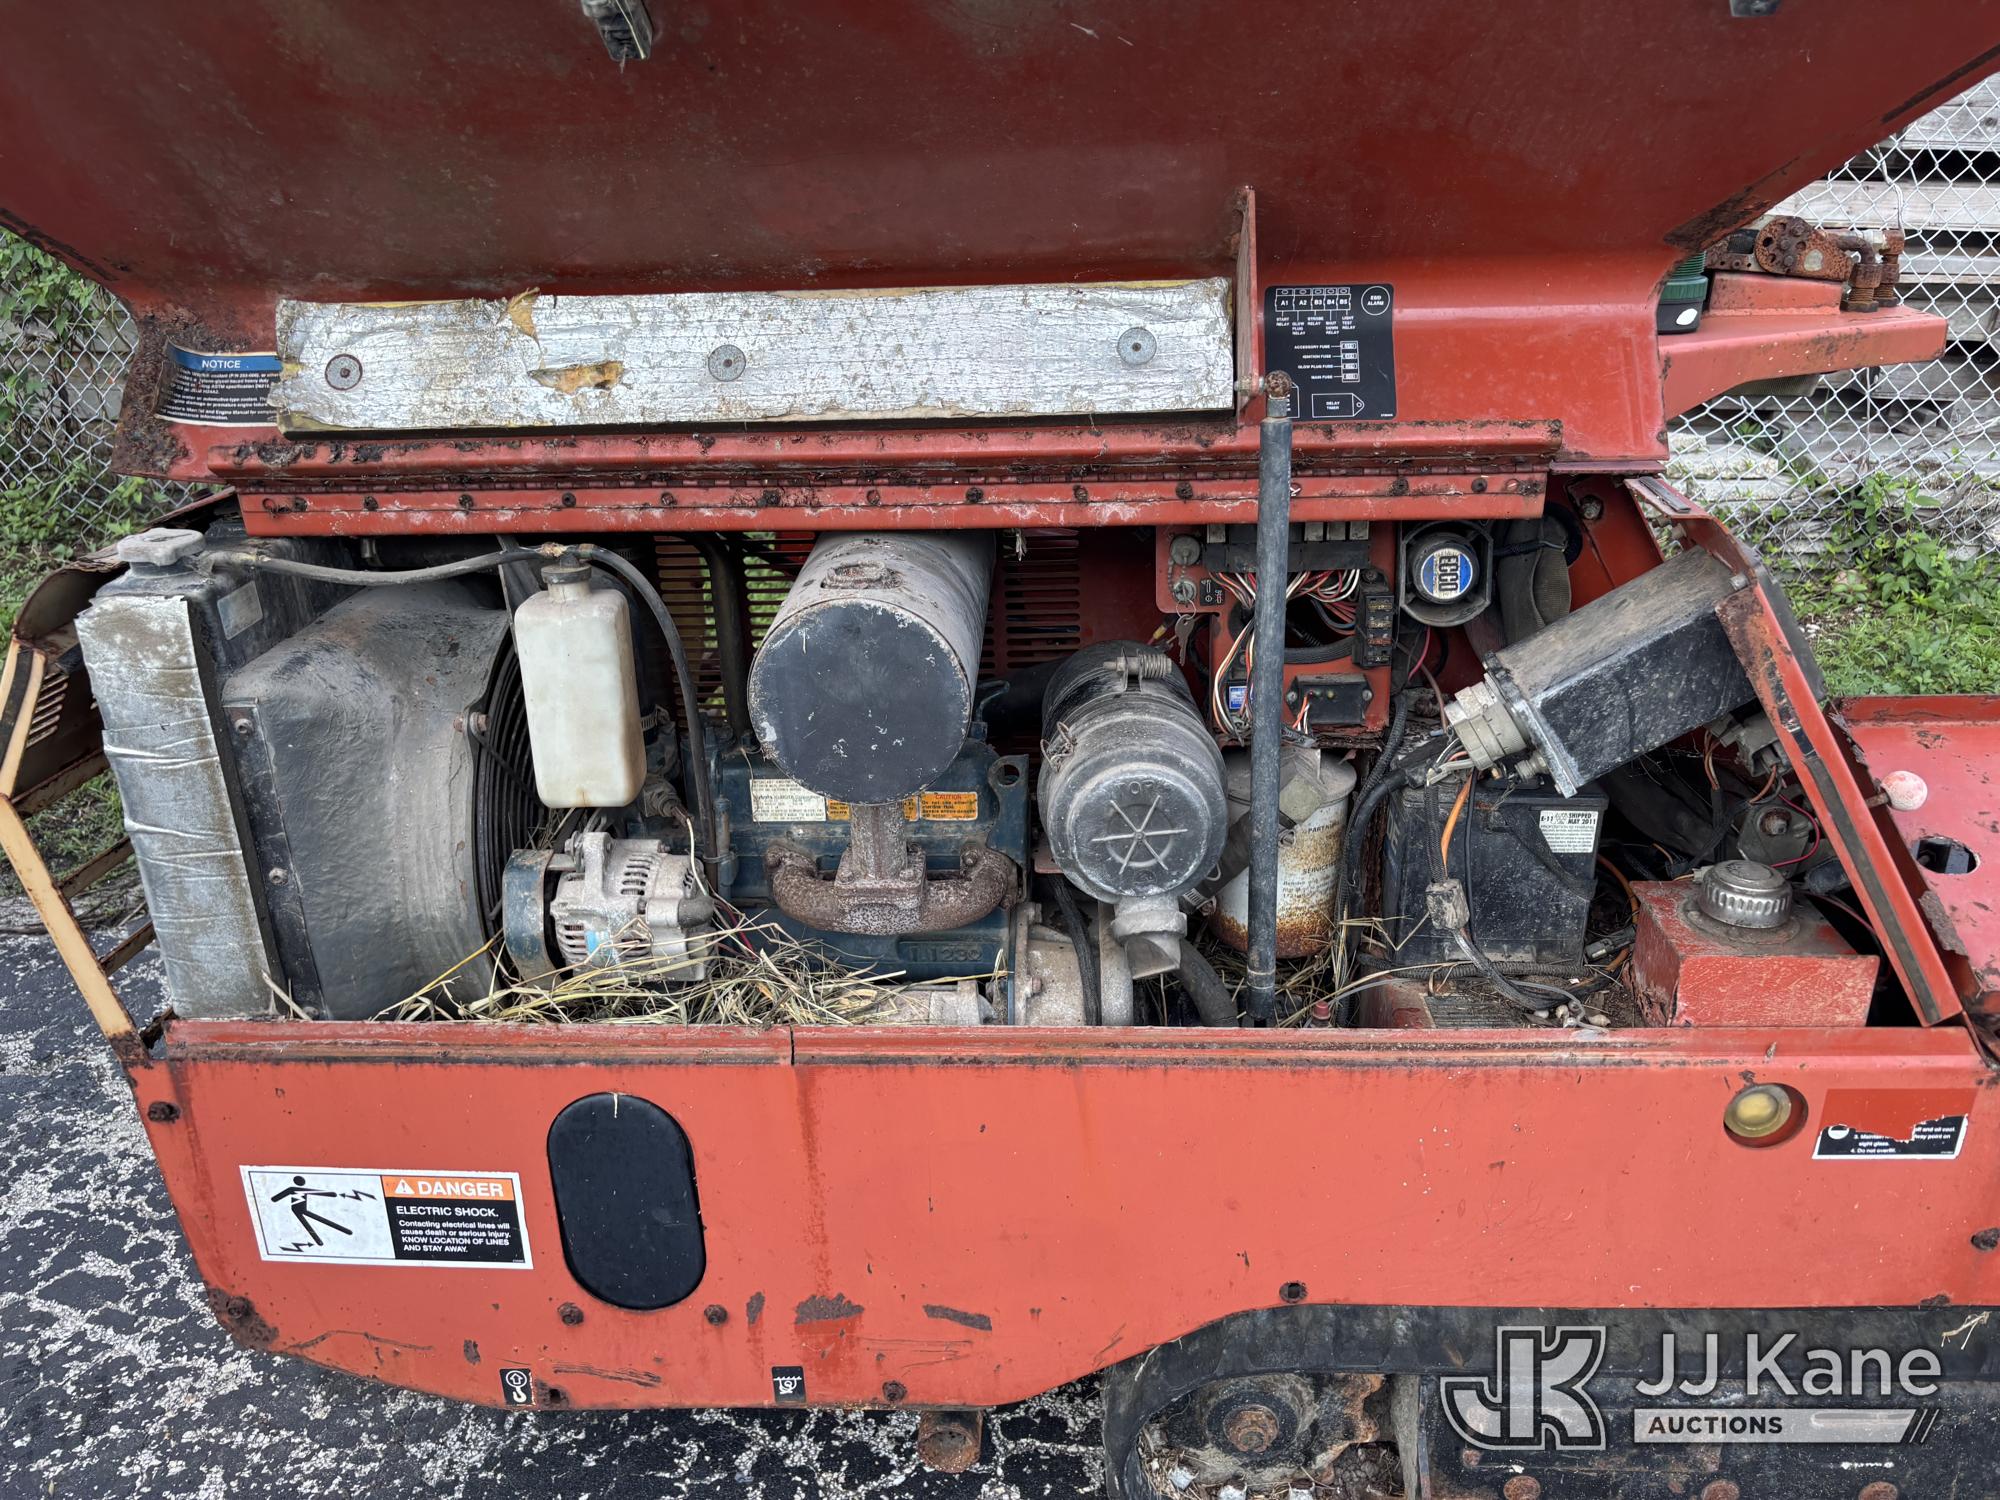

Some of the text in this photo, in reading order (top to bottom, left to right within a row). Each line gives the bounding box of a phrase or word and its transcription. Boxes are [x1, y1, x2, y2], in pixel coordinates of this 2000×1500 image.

[202, 360, 241, 369] NOTICE
[1438, 556, 1458, 592] ECCO
[417, 1181, 505, 1197] DANGER
[396, 1206, 499, 1217] ELECTRIC SHOCK.
[399, 1220, 440, 1229] Contacting
[442, 1221, 476, 1229] electrical
[488, 1231, 511, 1239] injury.
[402, 1236, 428, 1244] KNOW
[430, 1237, 471, 1245] LOCATION
[403, 1244, 421, 1252] AND
